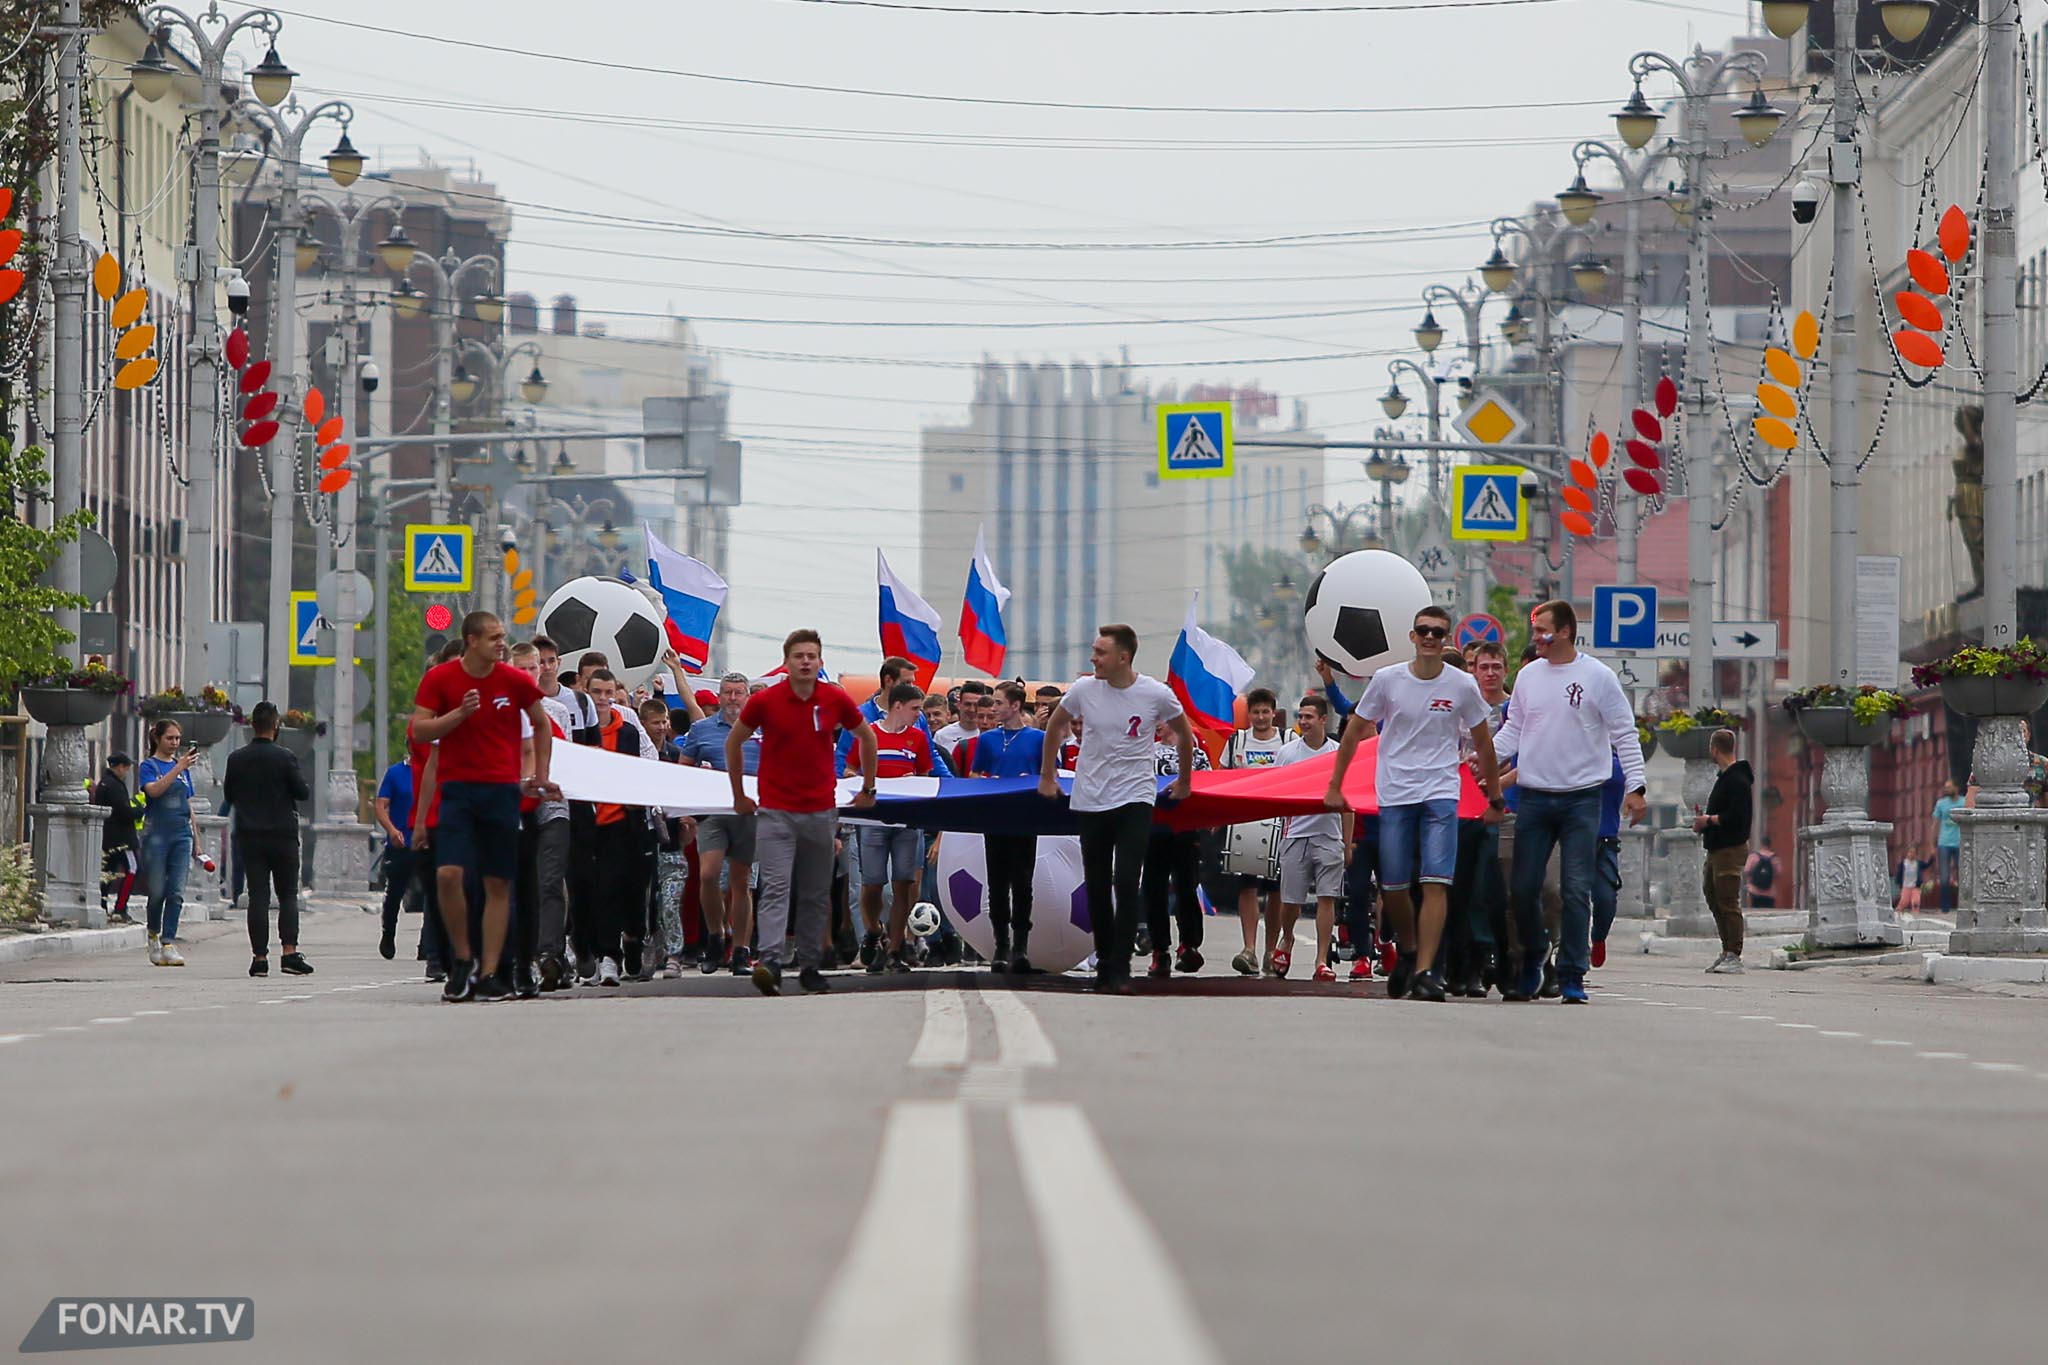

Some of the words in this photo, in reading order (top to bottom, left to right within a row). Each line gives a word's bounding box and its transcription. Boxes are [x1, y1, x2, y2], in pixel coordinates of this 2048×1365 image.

[1993, 624, 2008, 636] 10
[1576, 635, 1591, 647] л.
[1840, 667, 1848, 679] 9
